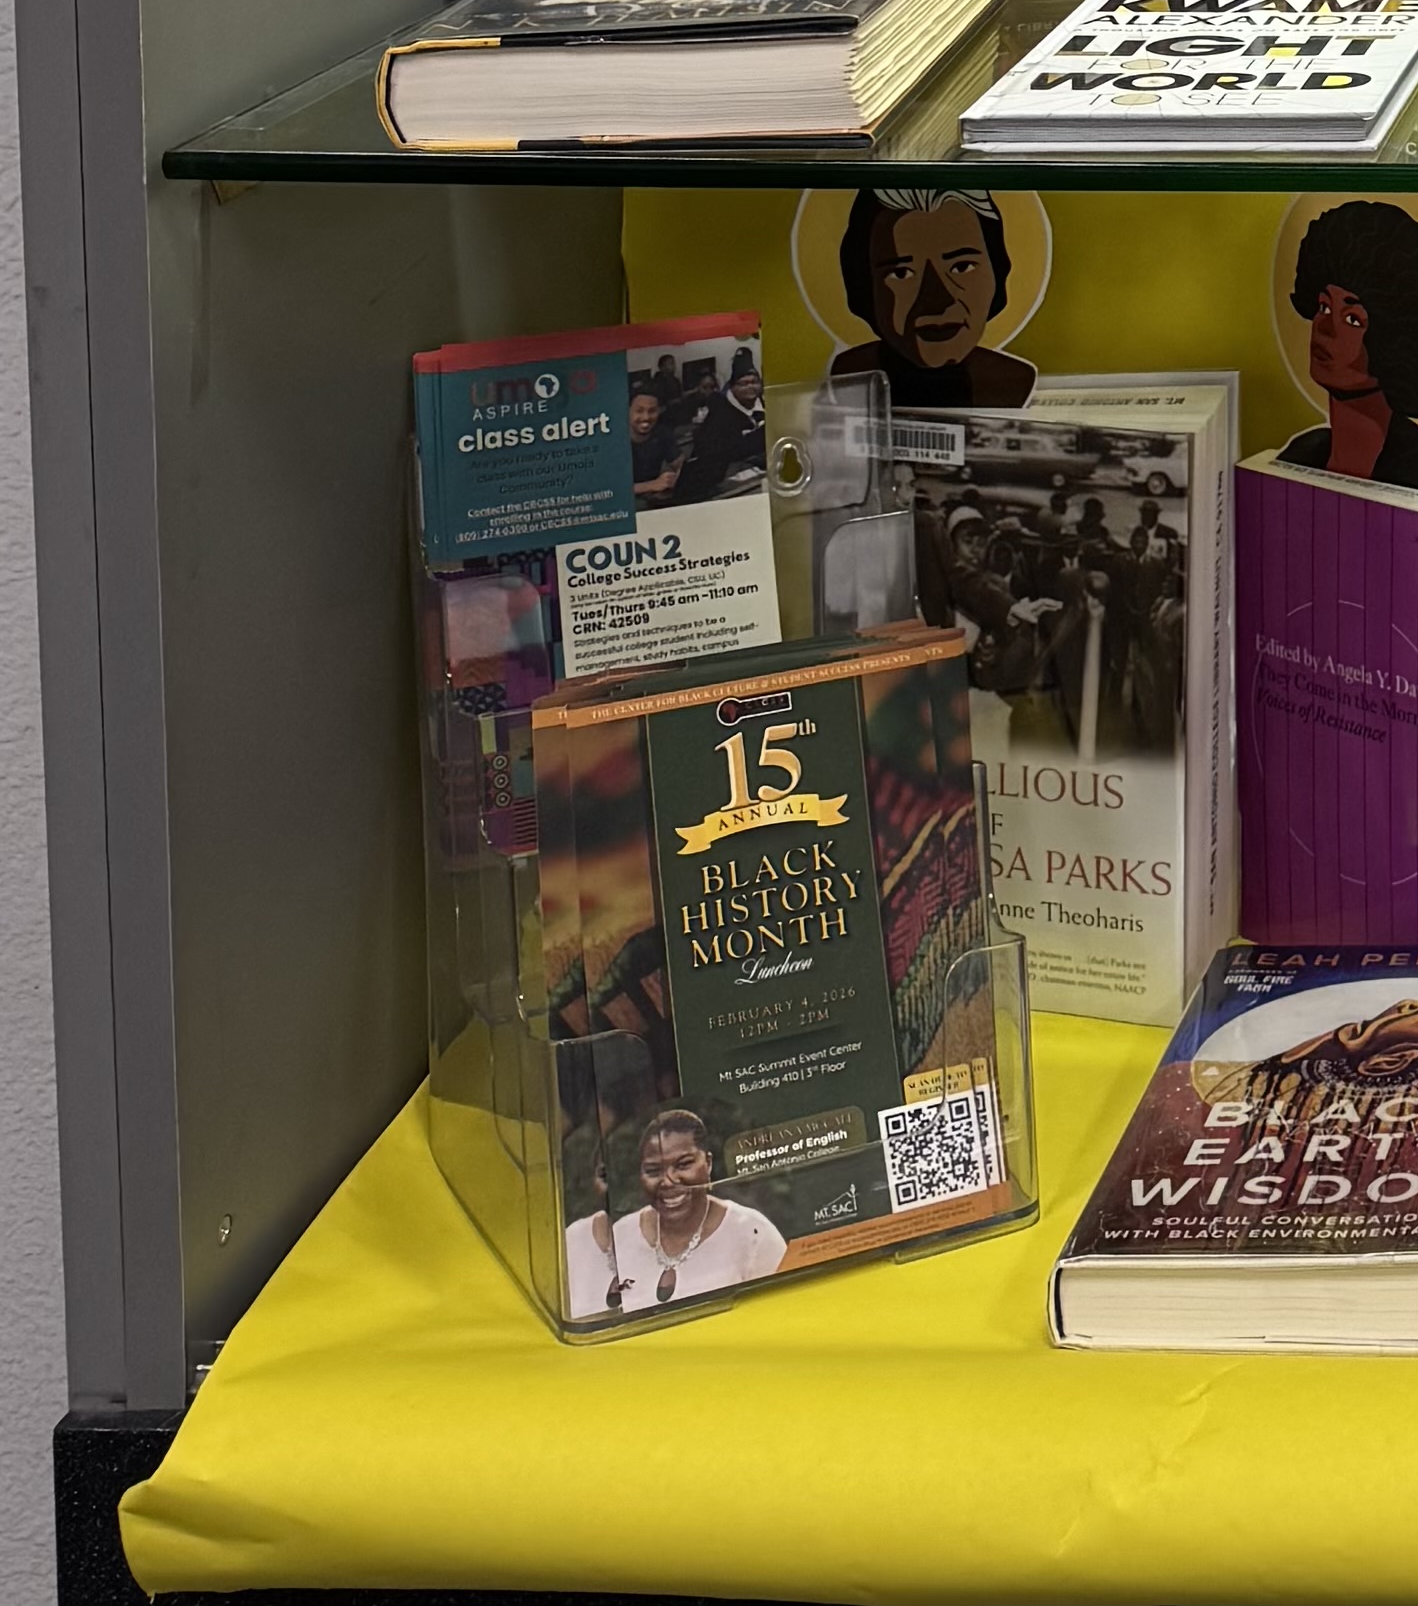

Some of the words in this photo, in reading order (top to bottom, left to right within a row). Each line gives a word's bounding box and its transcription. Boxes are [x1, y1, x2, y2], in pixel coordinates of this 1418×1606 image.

[1056, 35, 1397, 57] LIGHT
[1028, 72, 1372, 92] WORLD
[458, 427, 535, 452] class
[542, 413, 610, 441] alert
[565, 537, 657, 573] COUN
[662, 534, 683, 561] 2
[714, 719, 816, 812] 15th
[718, 802, 809, 831] ANNUAL
[702, 841, 837, 894] BLACK
[680, 869, 863, 936] HISTORY
[691, 908, 848, 968] MONTH
